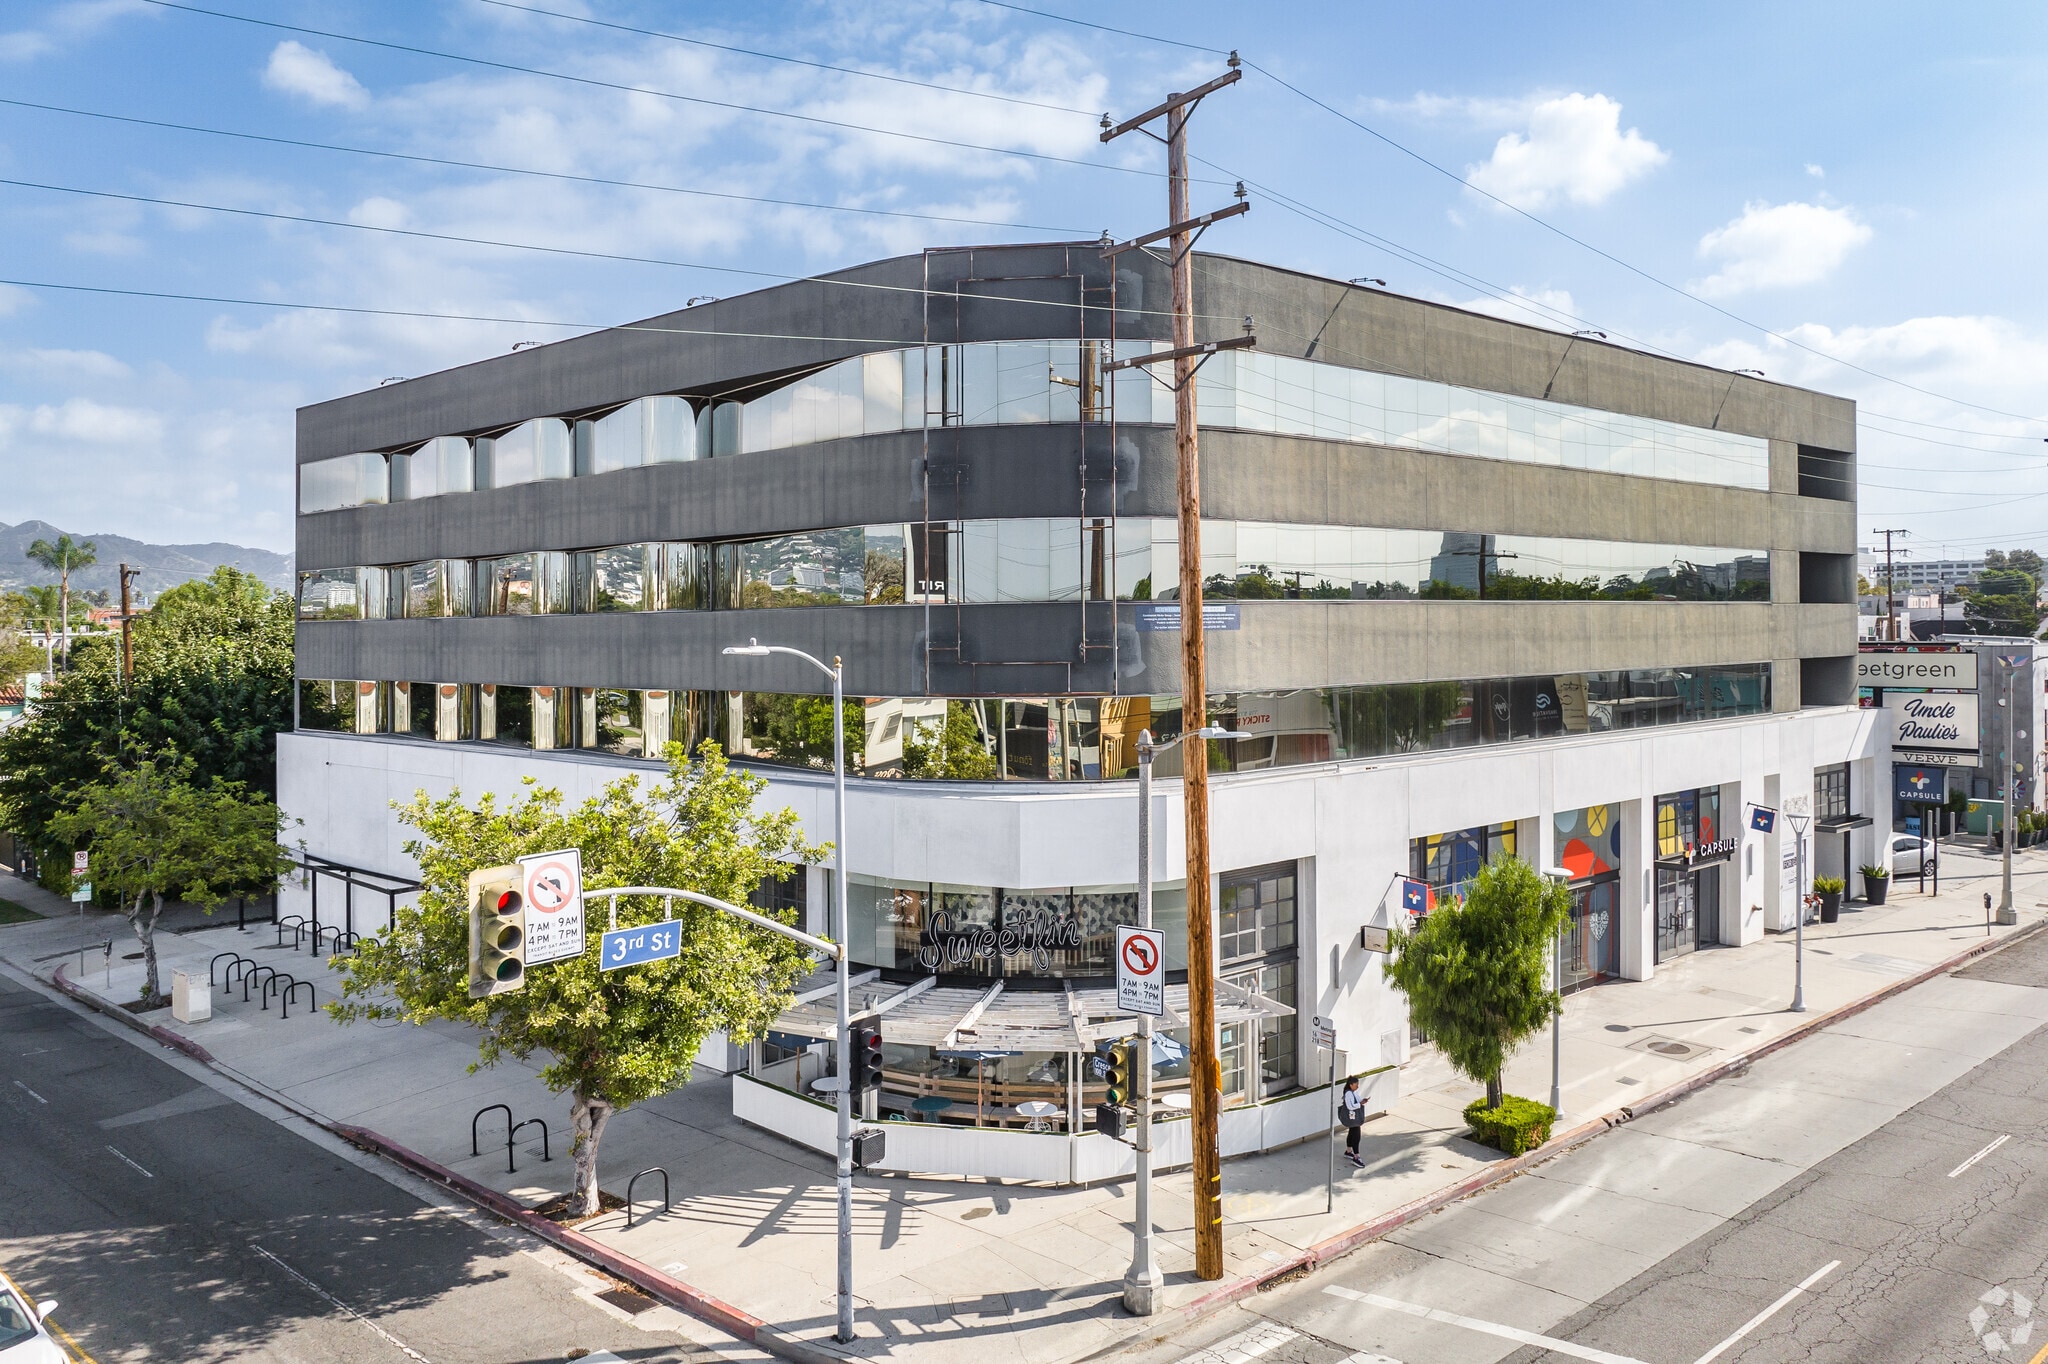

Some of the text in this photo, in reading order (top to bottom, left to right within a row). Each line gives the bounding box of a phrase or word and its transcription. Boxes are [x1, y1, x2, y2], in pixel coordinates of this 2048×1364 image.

[1904, 698, 1956, 718] Uncle
[1899, 720, 1960, 741] Paulie's
[1903, 754, 1958, 764] VERVE
[1899, 790, 1942, 800] CAPSULE
[1701, 837, 1738, 856] CAPSULE
[611, 931, 672, 961] 3rd St
[920, 909, 1082, 970] Sweetfin
